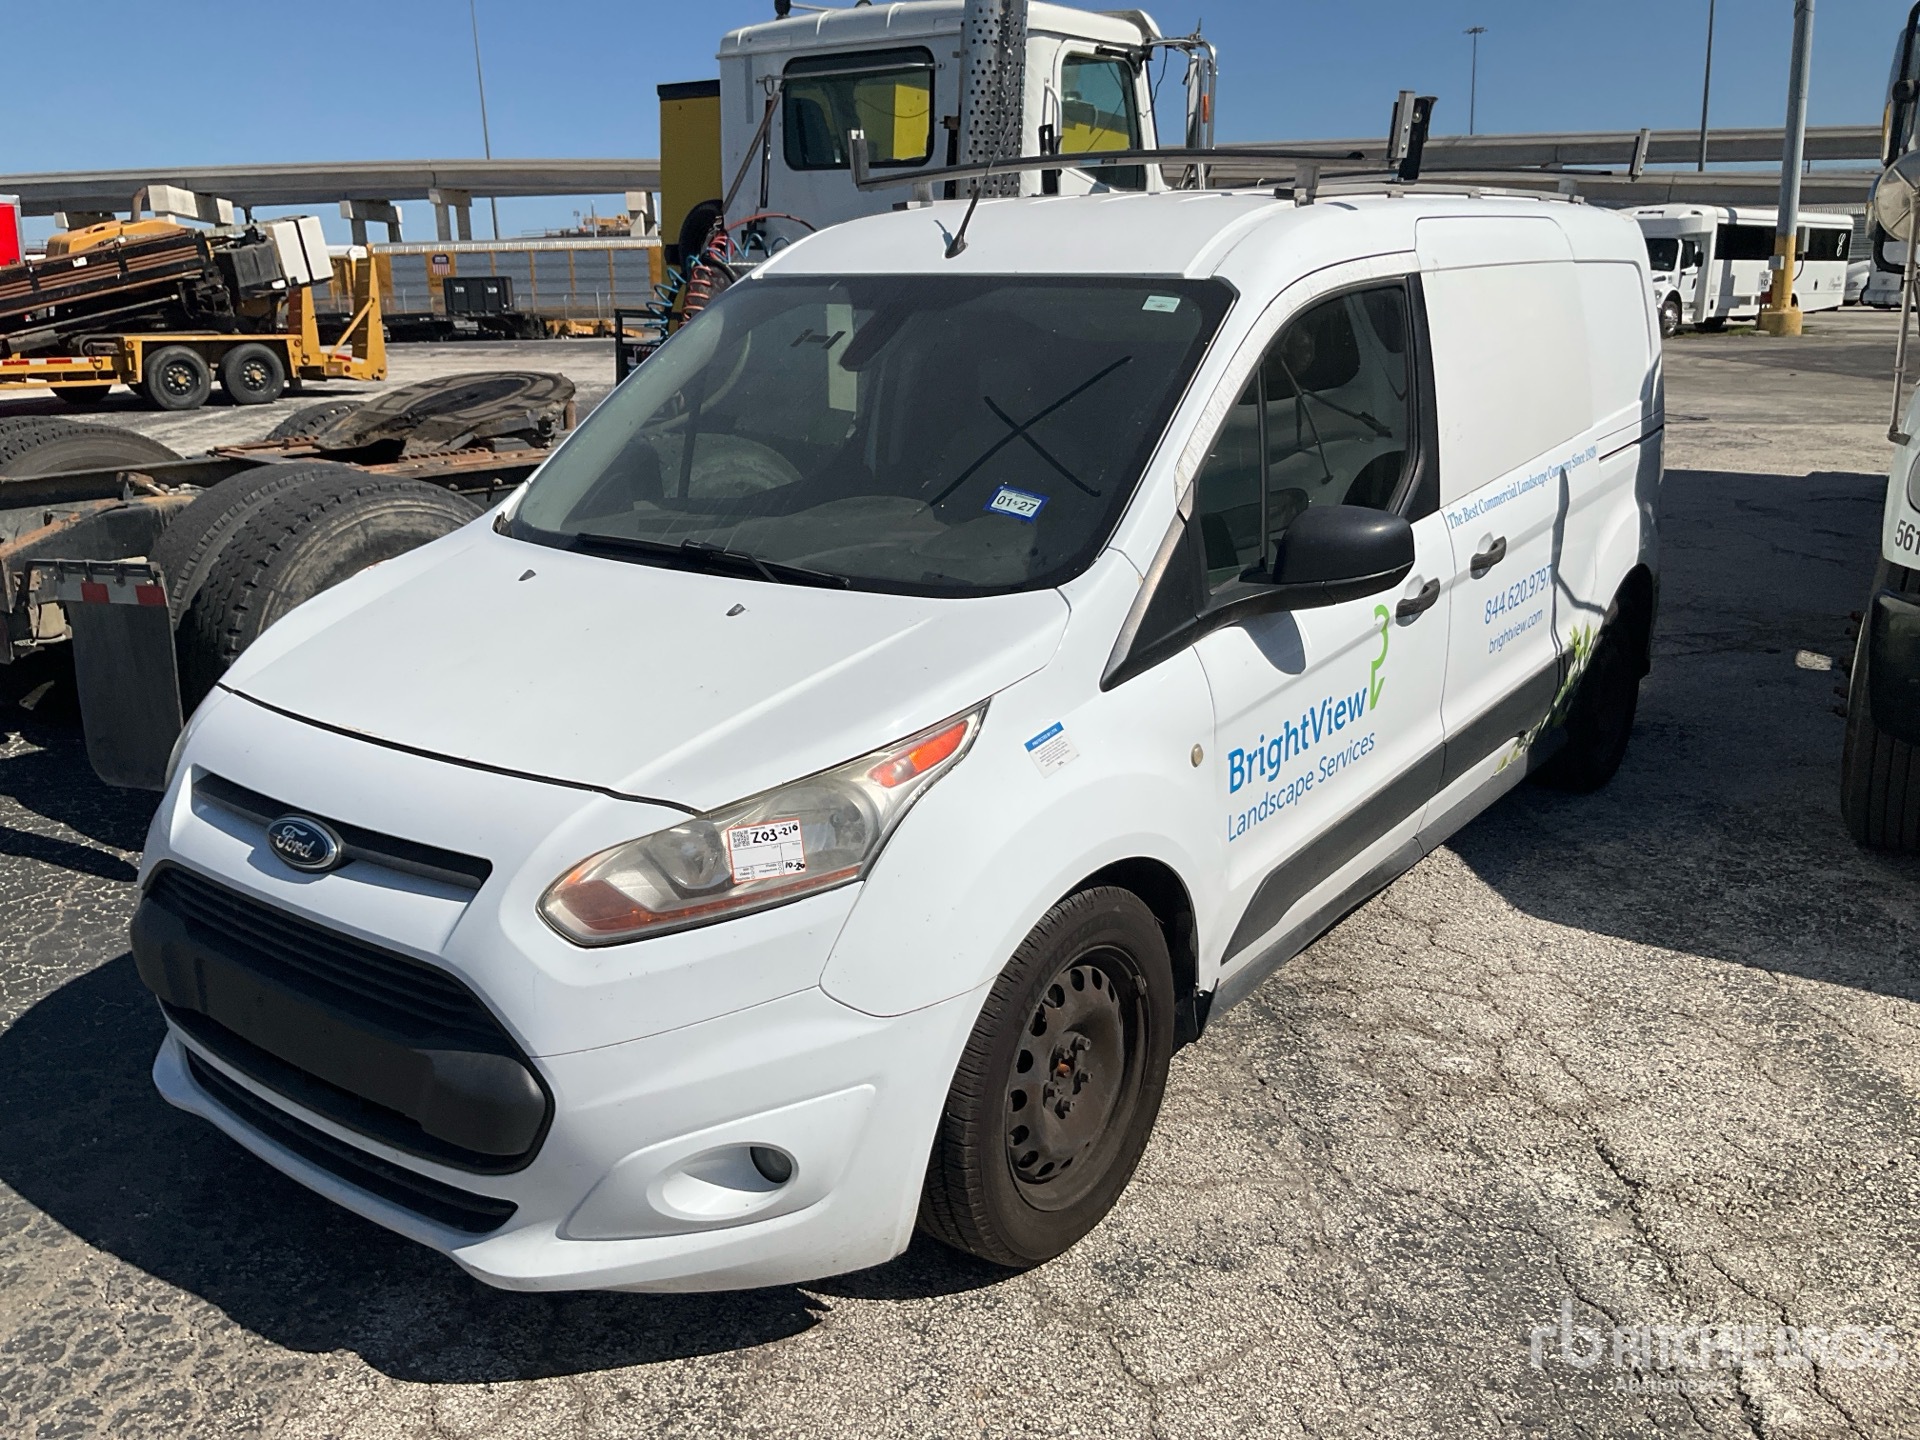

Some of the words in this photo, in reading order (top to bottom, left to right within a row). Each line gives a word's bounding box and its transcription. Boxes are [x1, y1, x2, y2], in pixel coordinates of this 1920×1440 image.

[1760, 278, 1769, 287] 10
[997, 495, 1013, 507] 01
[1017, 501, 1037, 512] 27
[1447, 512, 1463, 530] The
[1462, 504, 1479, 522] Best
[1478, 483, 1517, 513] Commercial
[1517, 472, 1548, 495] Landscape
[1484, 564, 1552, 625] 844.620.9797
[1488, 608, 1543, 654] brightview.com
[1227, 687, 1367, 794] BrightView
[1228, 771, 1314, 842] Landscape
[1317, 732, 1375, 784] Services
[275, 825, 316, 858] Ford
